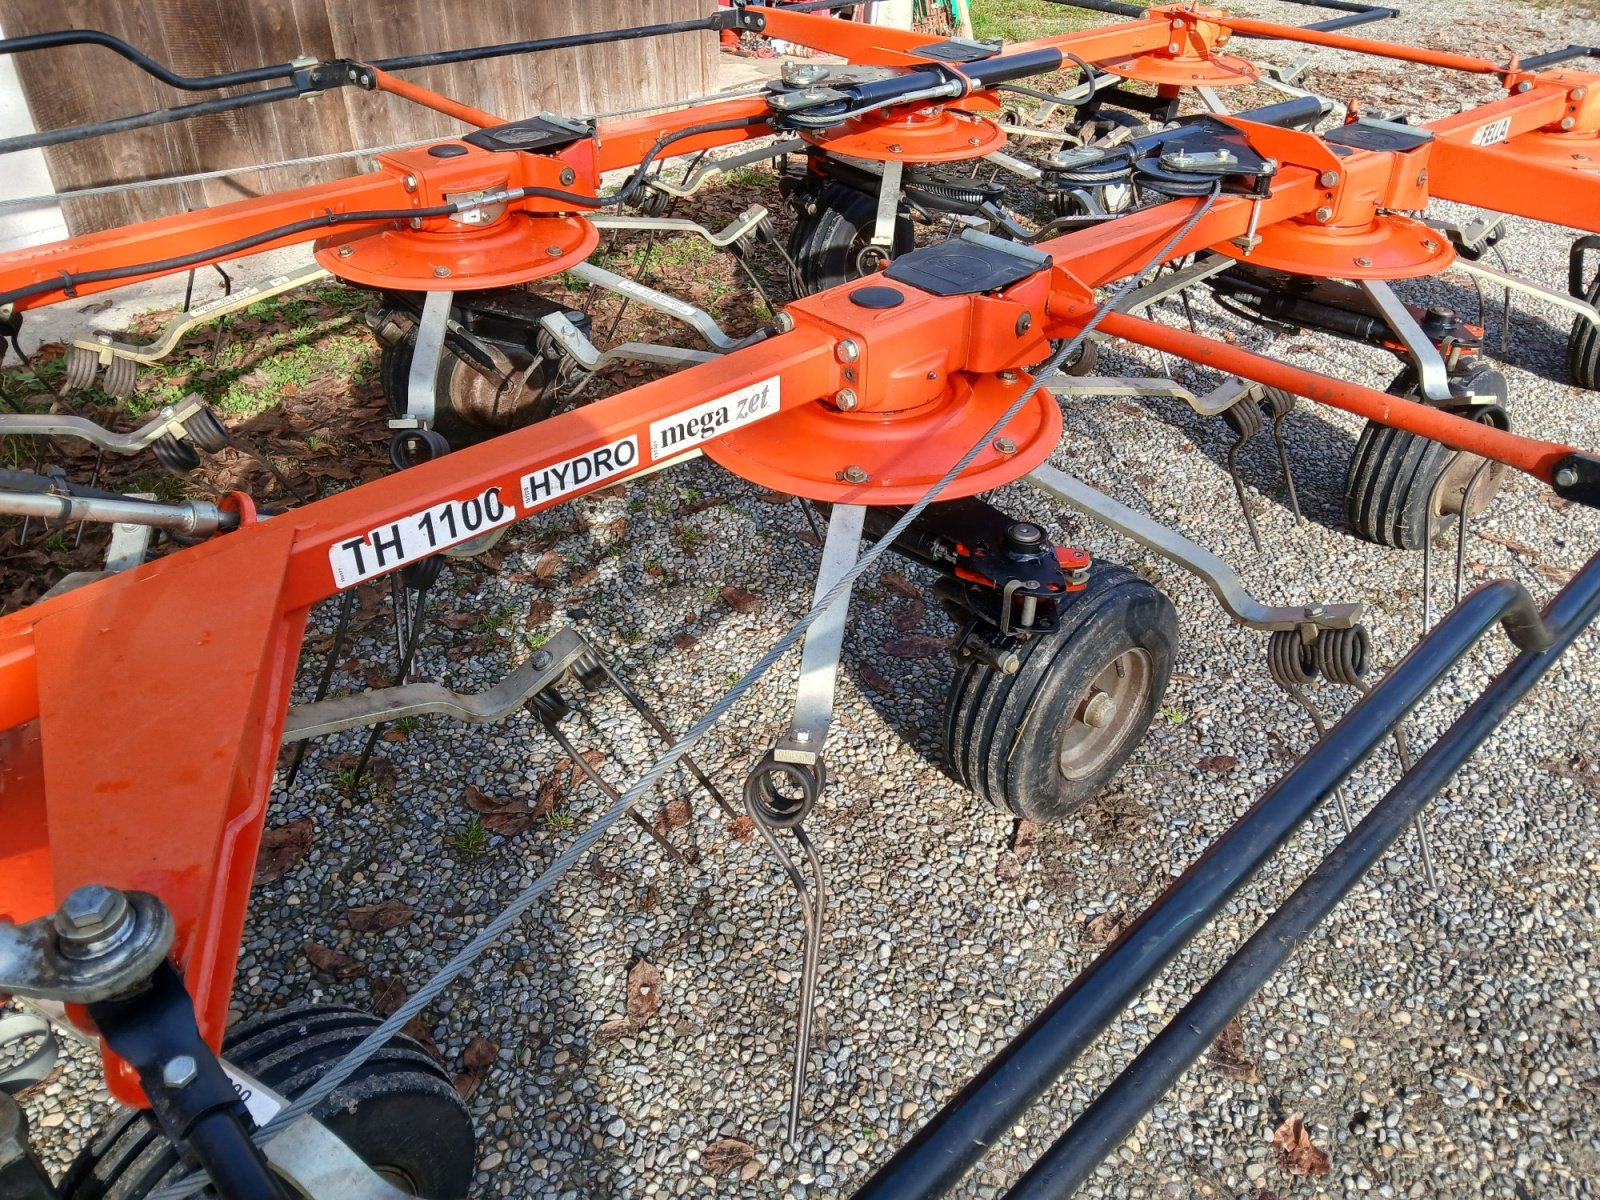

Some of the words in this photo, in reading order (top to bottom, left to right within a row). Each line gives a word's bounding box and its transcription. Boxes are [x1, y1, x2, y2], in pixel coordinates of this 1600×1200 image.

[1480, 119, 1508, 145] FELLA
[660, 406, 730, 448] mega
[736, 384, 770, 420] zet
[529, 440, 635, 502] HYDRO
[342, 524, 404, 576] TH
[418, 487, 504, 547] 1100
